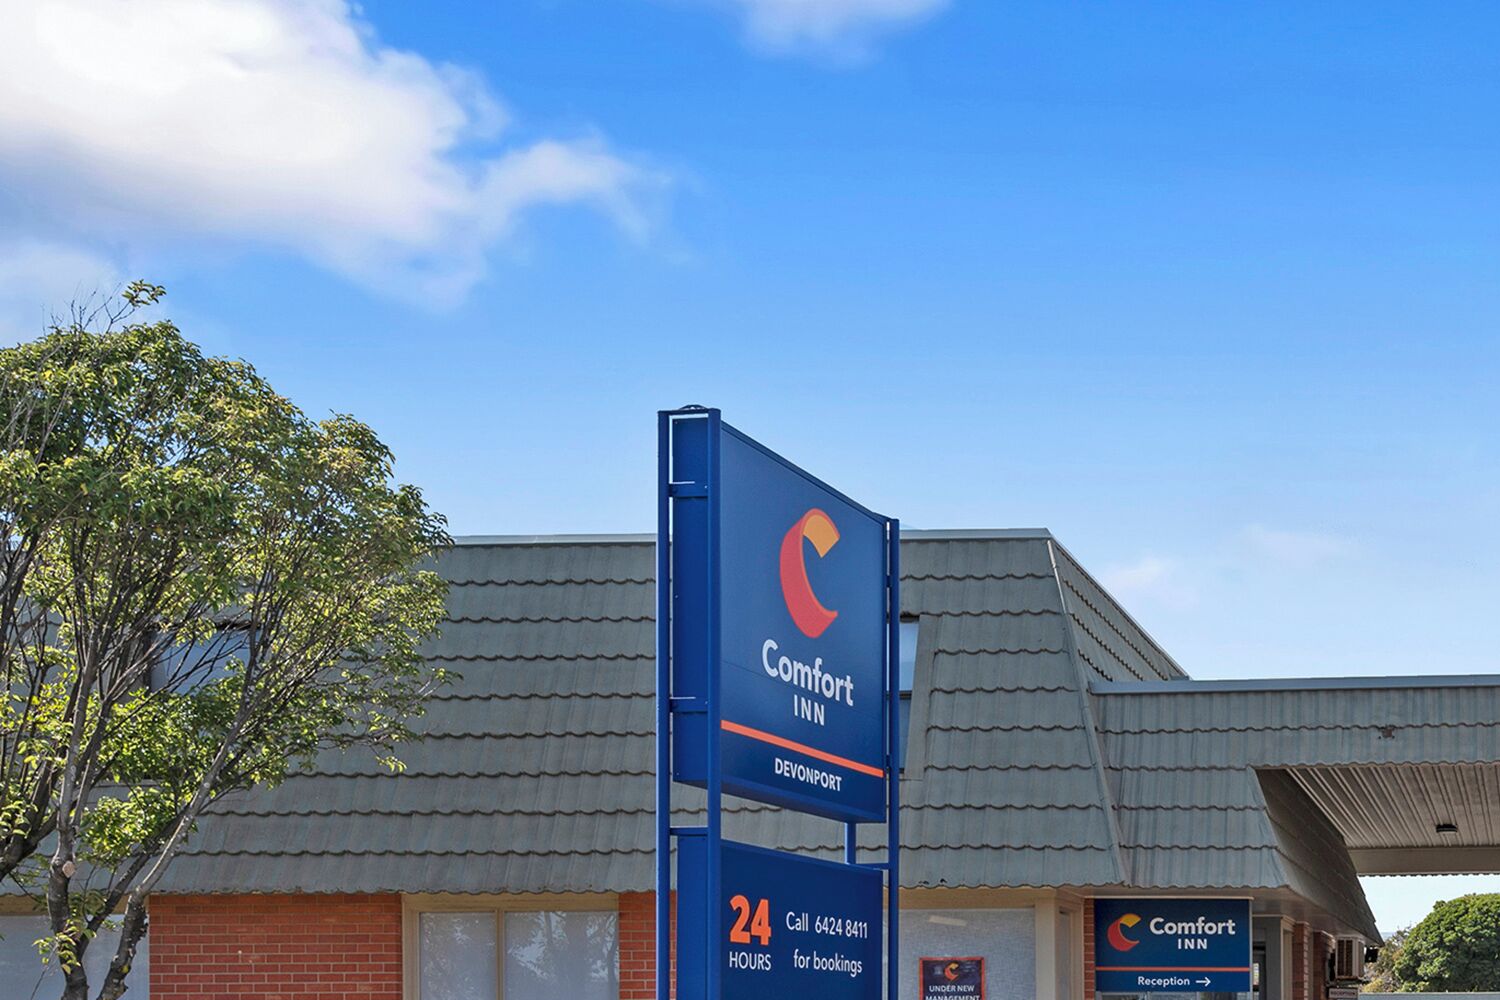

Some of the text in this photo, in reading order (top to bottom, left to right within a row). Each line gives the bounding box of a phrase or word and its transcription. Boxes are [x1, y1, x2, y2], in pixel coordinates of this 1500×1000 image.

[762, 639, 854, 706] Comfort
[793, 694, 825, 726] INN
[775, 757, 842, 792] DEVONPORT
[730, 894, 772, 946] 24
[786, 911, 868, 939] Call 6424 8411
[1149, 916, 1236, 935] Comfort
[1177, 938, 1208, 950] INN
[729, 951, 772, 971] HOURS
[793, 948, 863, 978] for bookings
[1137, 976, 1190, 988] Reception
